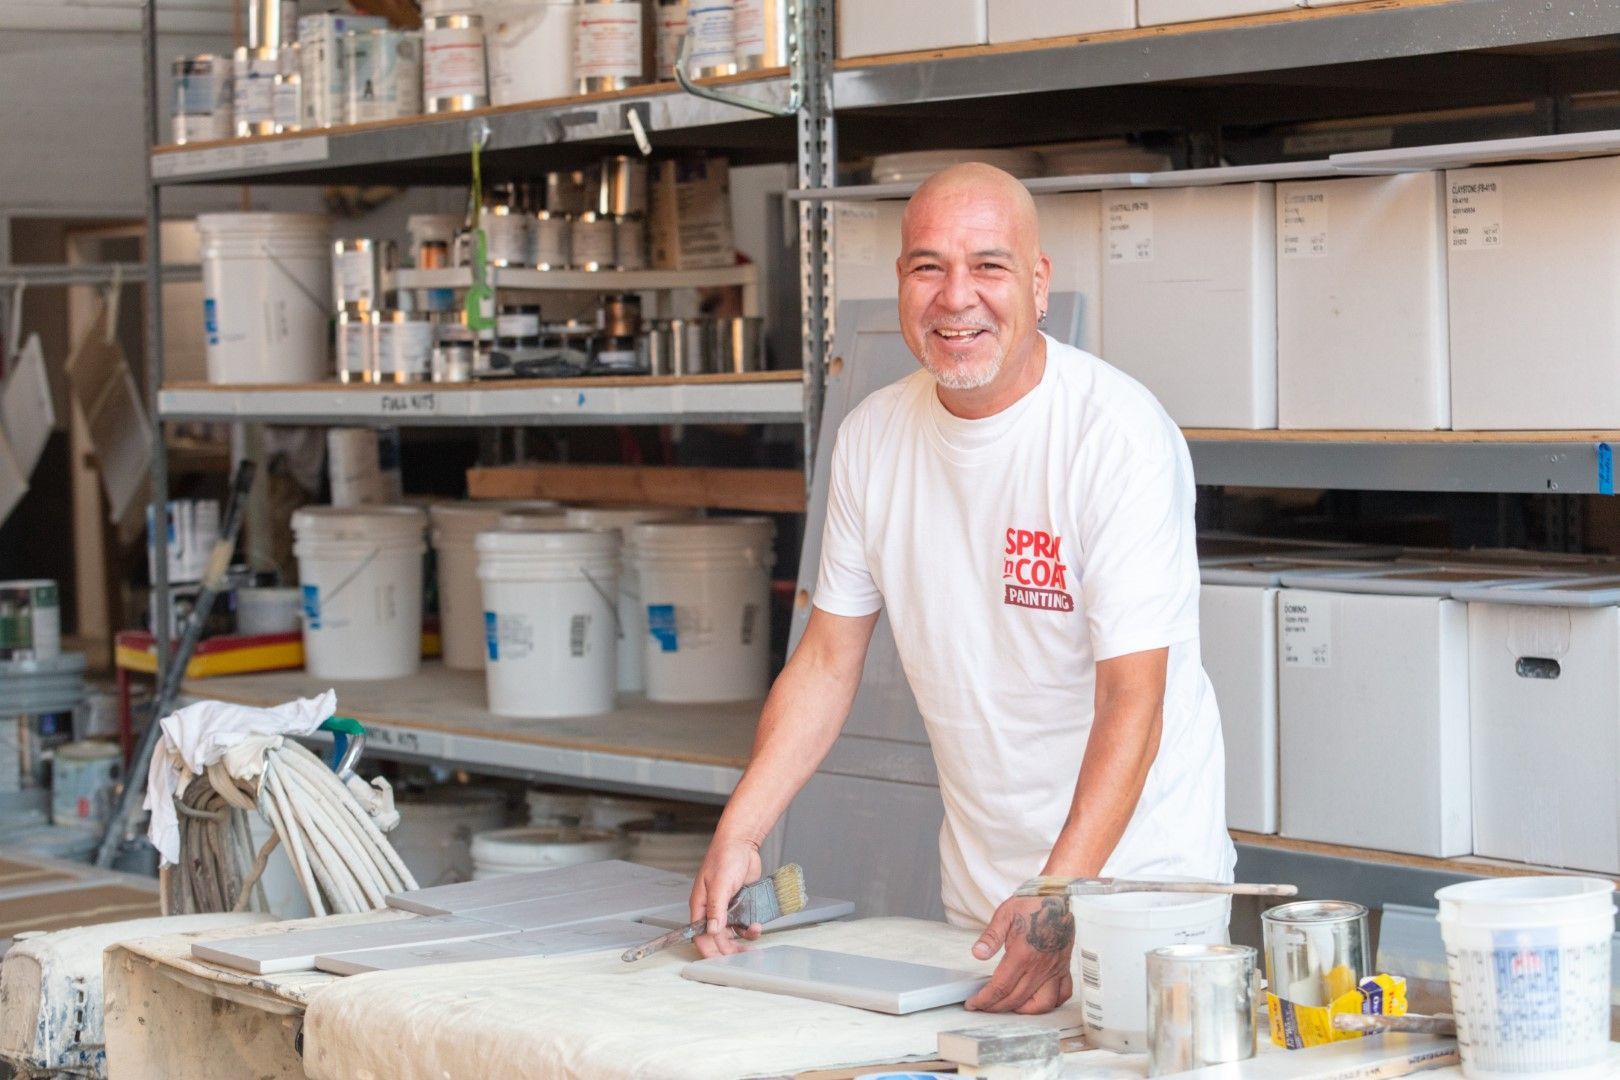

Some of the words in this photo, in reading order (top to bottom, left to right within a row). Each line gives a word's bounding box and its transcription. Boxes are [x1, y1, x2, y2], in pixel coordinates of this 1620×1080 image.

[1452, 185, 1477, 195] CLAYSTONE
[1009, 588, 1070, 610] PAINTING
[1284, 605, 1307, 614] DOMINO
